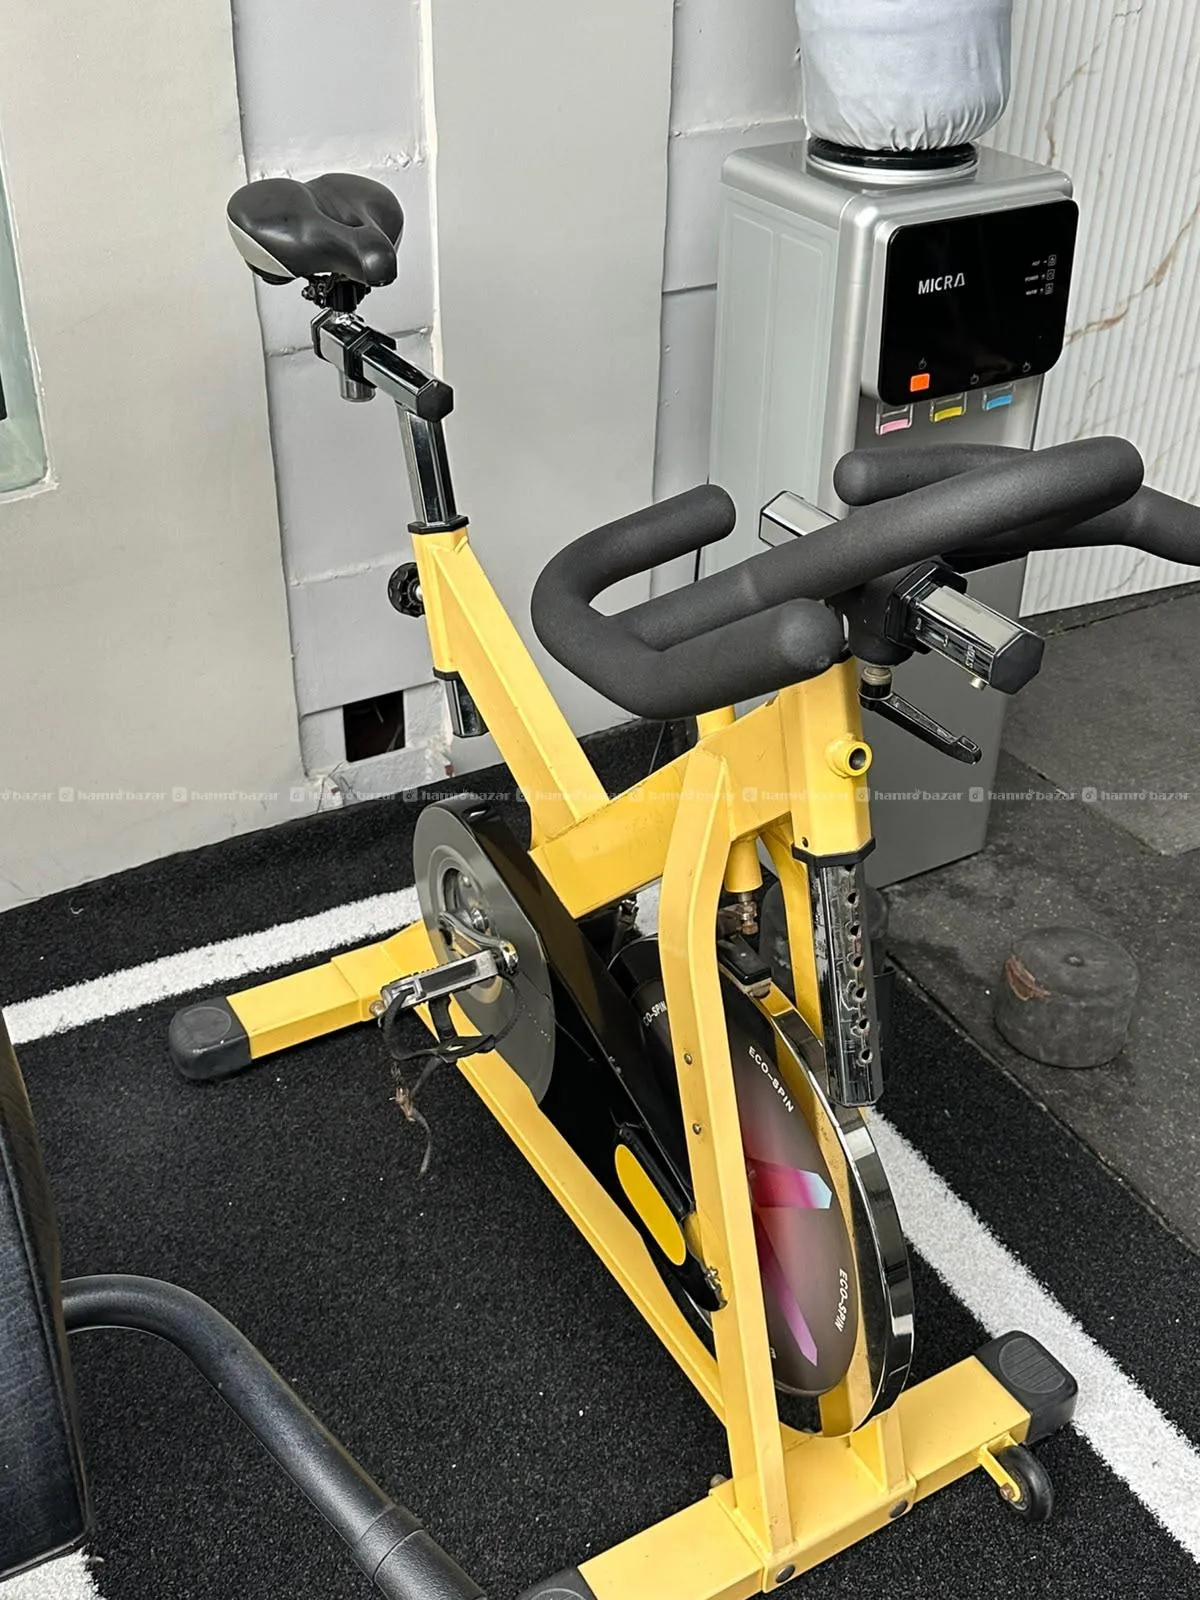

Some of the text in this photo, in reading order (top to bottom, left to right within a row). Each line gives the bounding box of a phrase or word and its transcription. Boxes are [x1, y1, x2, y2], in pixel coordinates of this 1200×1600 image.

[918, 272, 965, 295] MICRA
[643, 1000, 668, 1026] CO-SPIN
[748, 1045, 795, 1114] ECO-SPIN
[834, 1268, 850, 1333] ECO-SPIN
